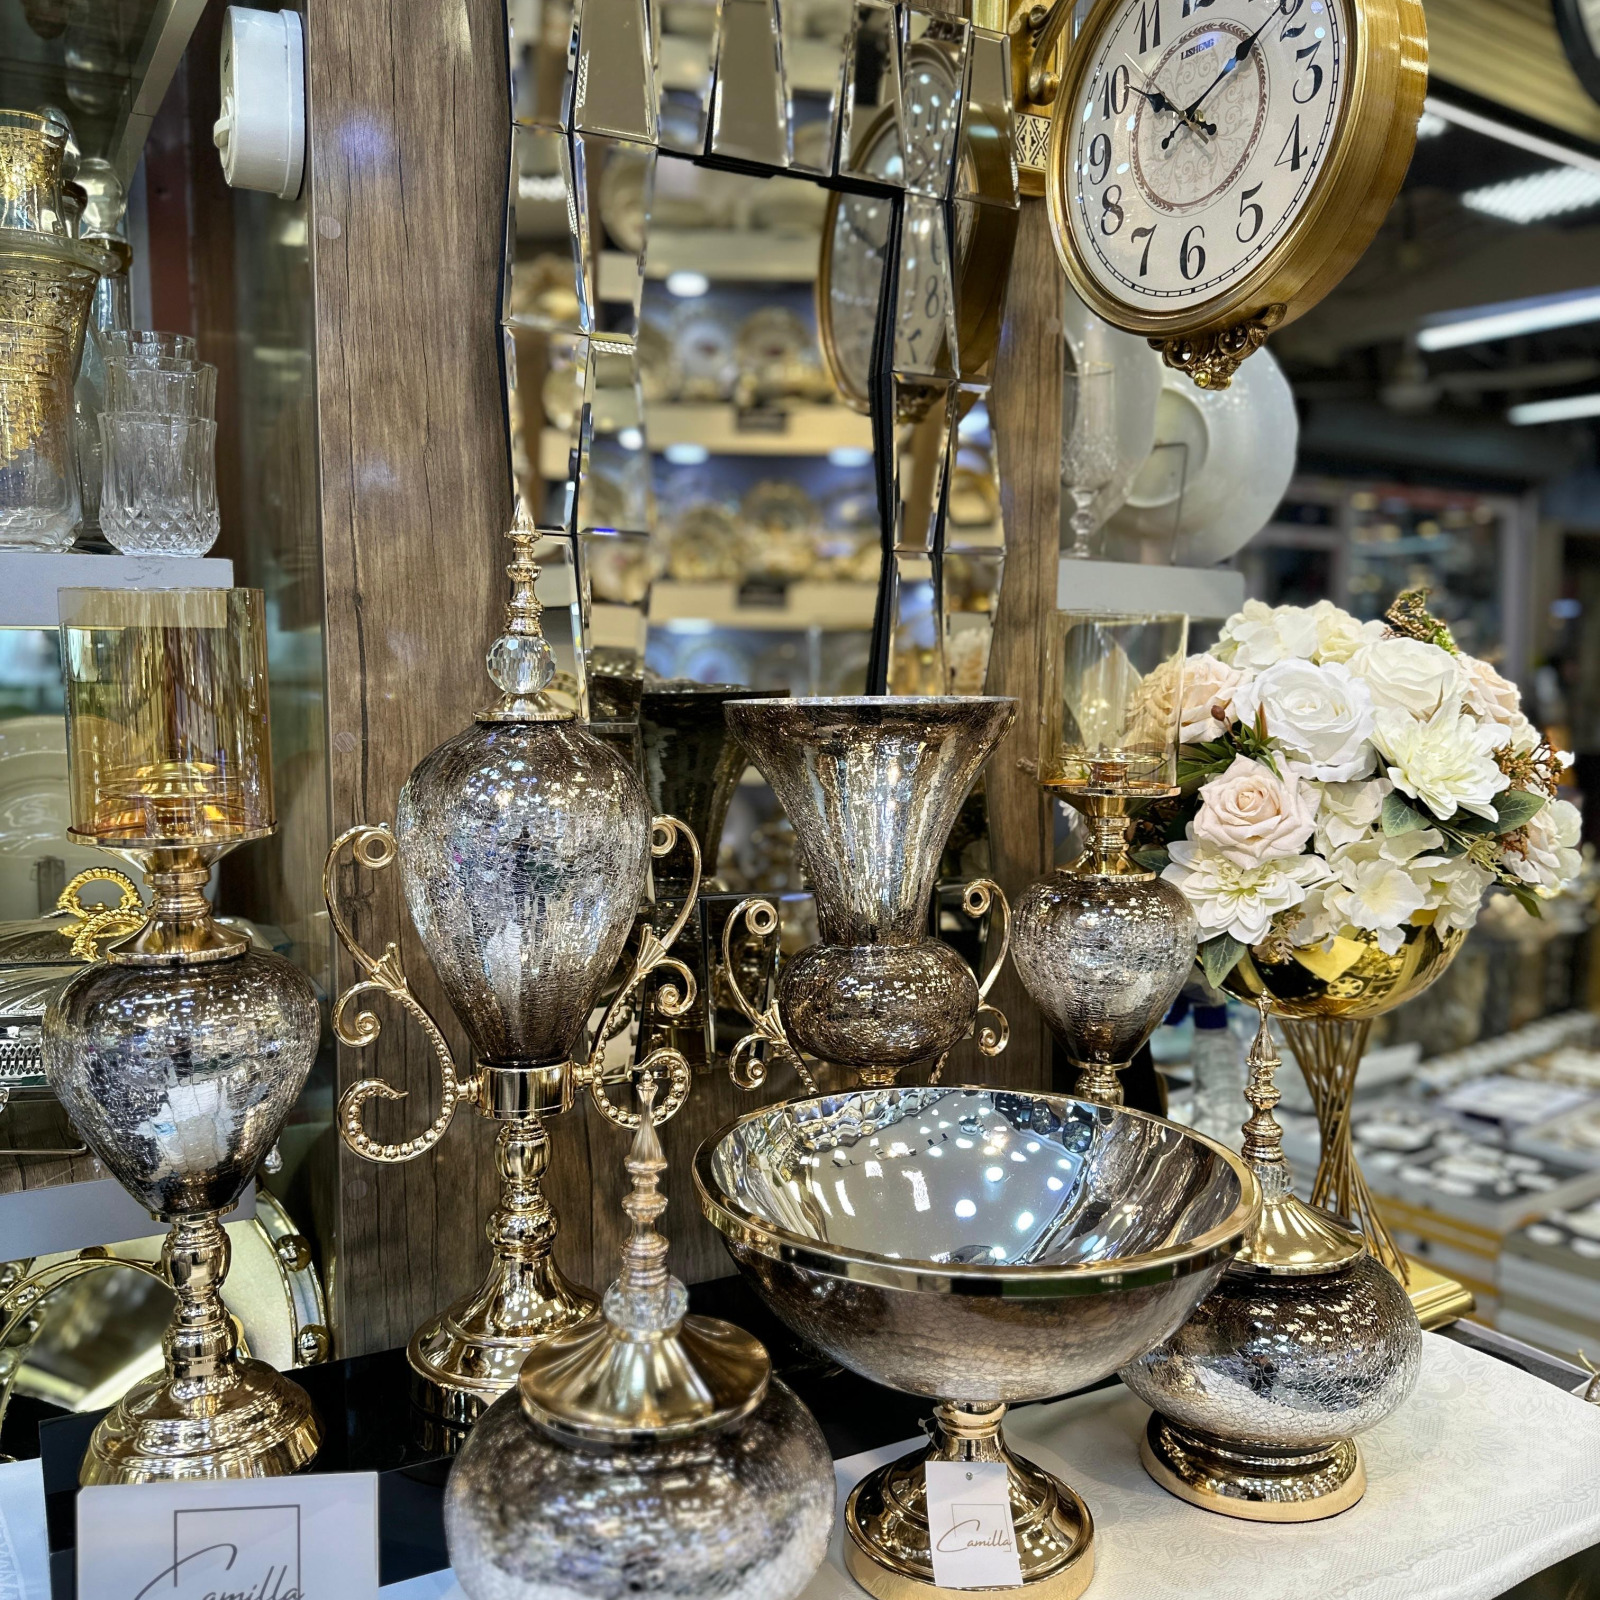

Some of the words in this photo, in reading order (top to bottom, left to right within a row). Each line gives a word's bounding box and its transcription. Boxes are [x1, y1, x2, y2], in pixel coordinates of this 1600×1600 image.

[1134, 0, 1161, 54] 11
[1098, 64, 1130, 121] 10
[1293, 41, 1322, 104] 3
[1089, 133, 1112, 186] 9
[1274, 113, 1308, 172] 4
[1101, 184, 1124, 236] 8
[1236, 181, 1264, 243] 5
[1131, 224, 1158, 277] 7
[1180, 225, 1206, 281] 6
[937, 1519, 1012, 1553] Camilla
